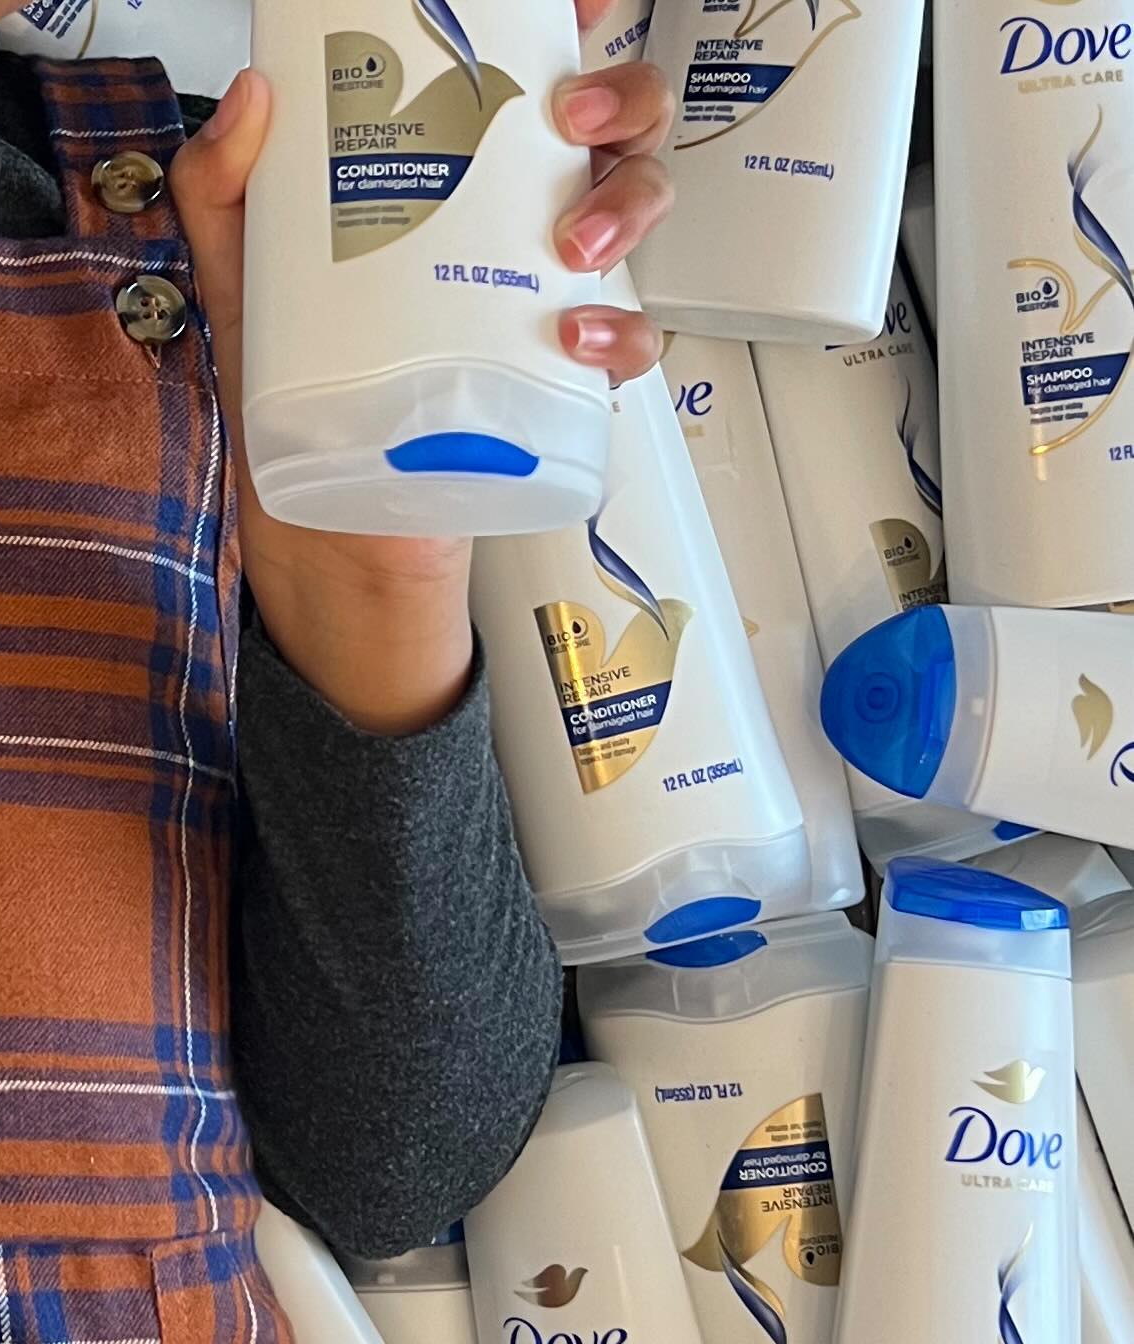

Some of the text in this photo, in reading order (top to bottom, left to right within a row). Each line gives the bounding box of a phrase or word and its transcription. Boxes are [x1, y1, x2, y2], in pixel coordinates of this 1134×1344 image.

[604, 44, 616, 58] 12
[696, 39, 764, 50] INTENSIVE
[1000, 16, 1132, 74] Dove
[694, 50, 740, 62] REPAIR
[332, 67, 363, 82] BIO
[690, 72, 752, 84] SHAMPOO
[1018, 69, 1124, 94] ULTRA CARE
[688, 84, 768, 95] for damaged hair
[334, 123, 426, 138] INTENSIVE
[334, 137, 397, 152] REPAIR
[336, 163, 450, 179] CONDITIONER
[744, 154, 834, 180] 12 FL OZ (355mL)
[337, 176, 444, 192] for damaged hair
[434, 264, 540, 294] 12 FL OZ (355mL)
[1016, 290, 1042, 304] BIO
[1022, 332, 1095, 352] INTENSIVE
[842, 348, 886, 368] ULTRA
[1022, 346, 1074, 364] REPAIR
[1026, 366, 1093, 386] SHAMPOO
[1044, 375, 1112, 394] damaged hair
[1109, 446, 1122, 461] 12
[547, 632, 571, 646] BIO
[570, 694, 656, 726] CONDITIONER
[572, 708, 654, 736] for hair
[662, 758, 744, 794] 12 FL OZ (355mL)
[698, 1082, 743, 1100] 12 FL OZ
[945, 1106, 1062, 1169] Dove
[762, 1151, 807, 1166] damaged
[738, 1161, 828, 1182] CONDITIONER
[961, 1173, 1012, 1190] ULTRA
[783, 1183, 831, 1198] REPAIR
[762, 1194, 834, 1212] INTENSIVE
[816, 1244, 840, 1256] BIO
